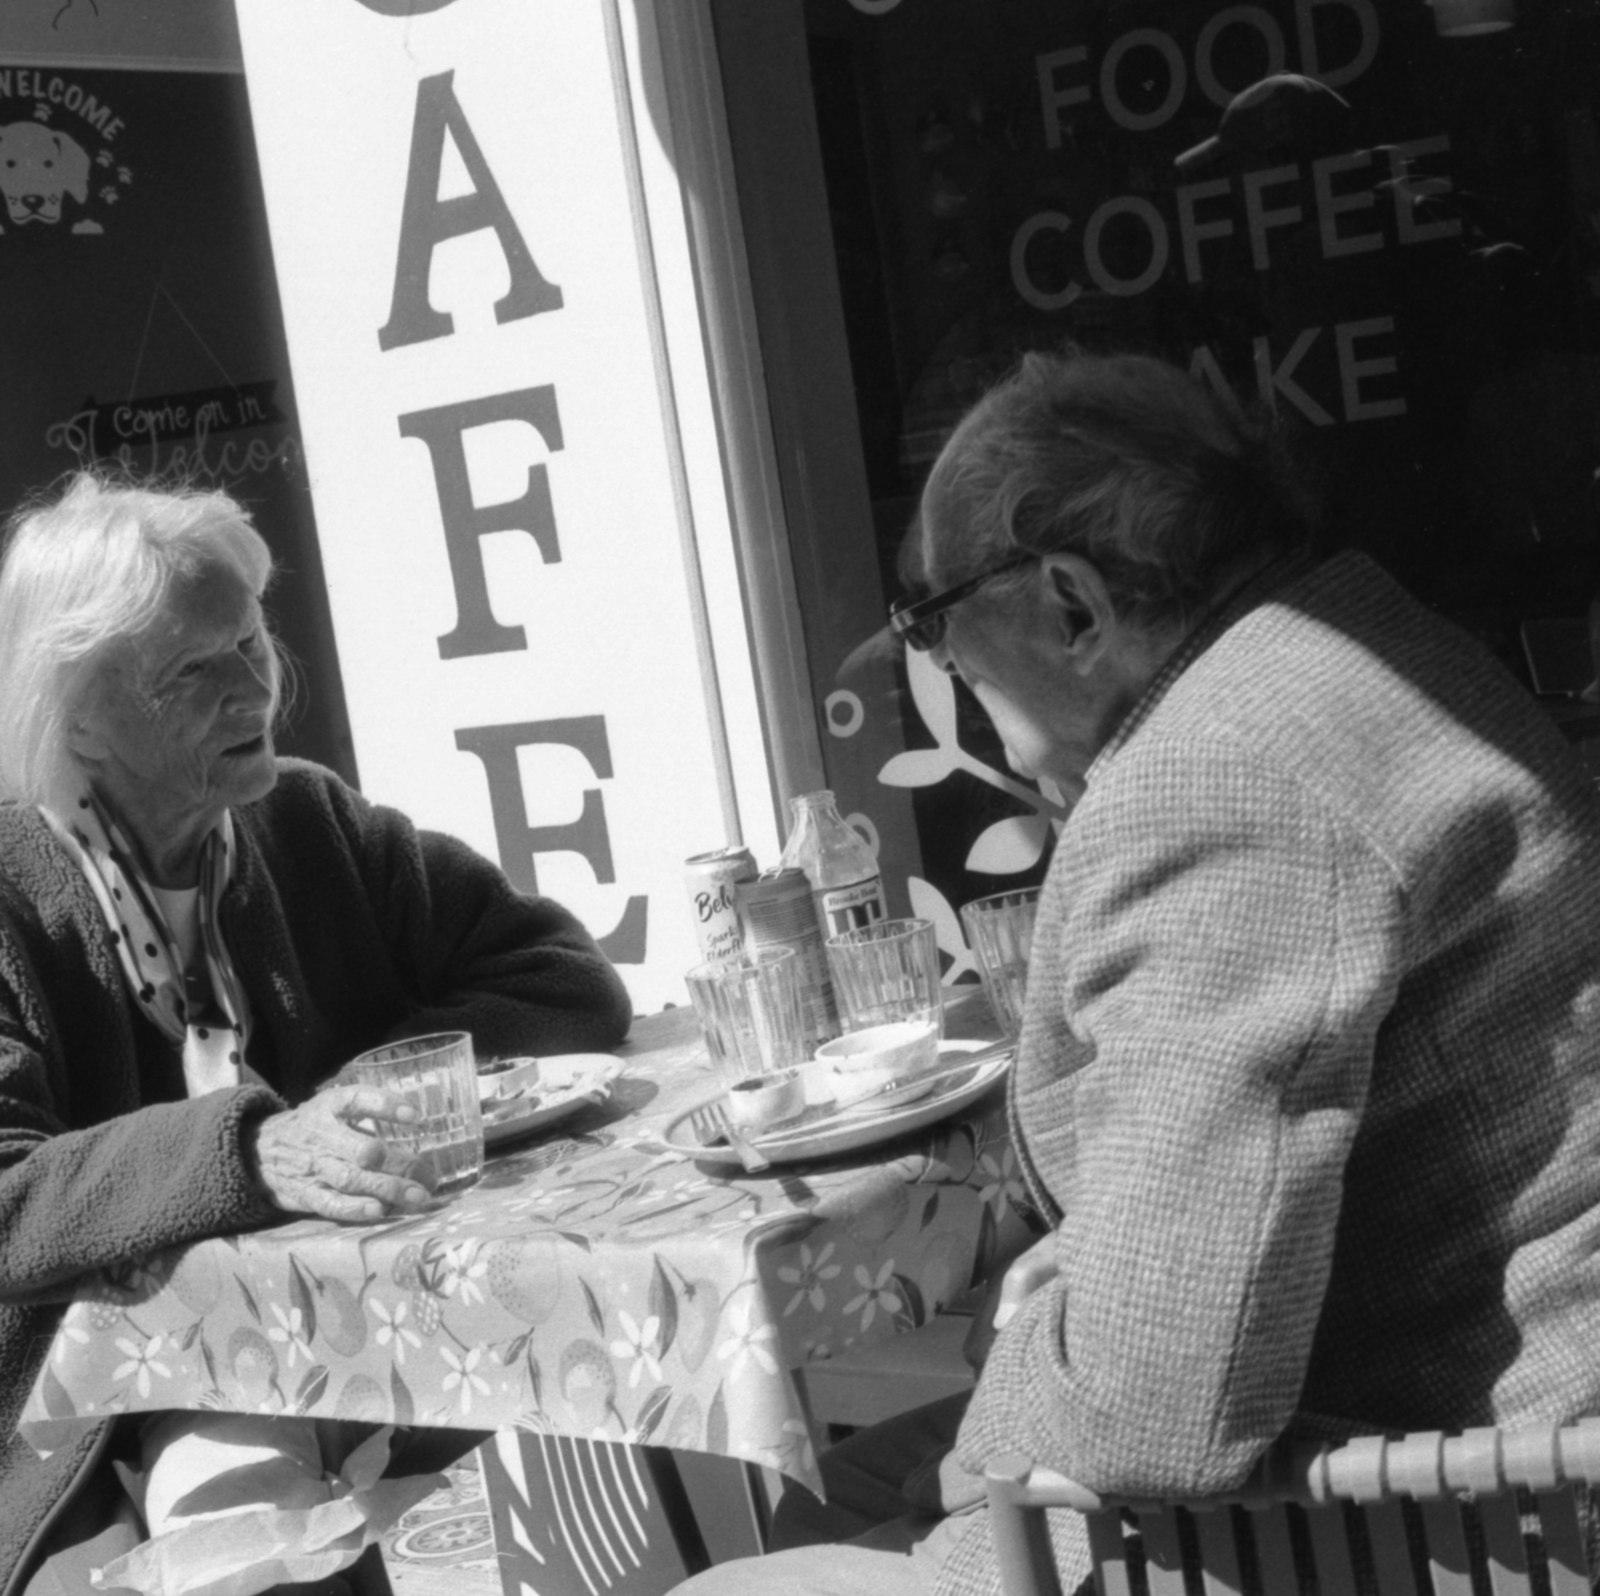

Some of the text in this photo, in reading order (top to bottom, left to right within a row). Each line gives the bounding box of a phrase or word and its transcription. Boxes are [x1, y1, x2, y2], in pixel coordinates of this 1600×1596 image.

[1035, 0, 1381, 150] FOOD
[1009, 134, 1462, 311] COFFEE
[113, 402, 191, 438] Come
[238, 395, 267, 424] in
[355, 0, 648, 966] AFE
